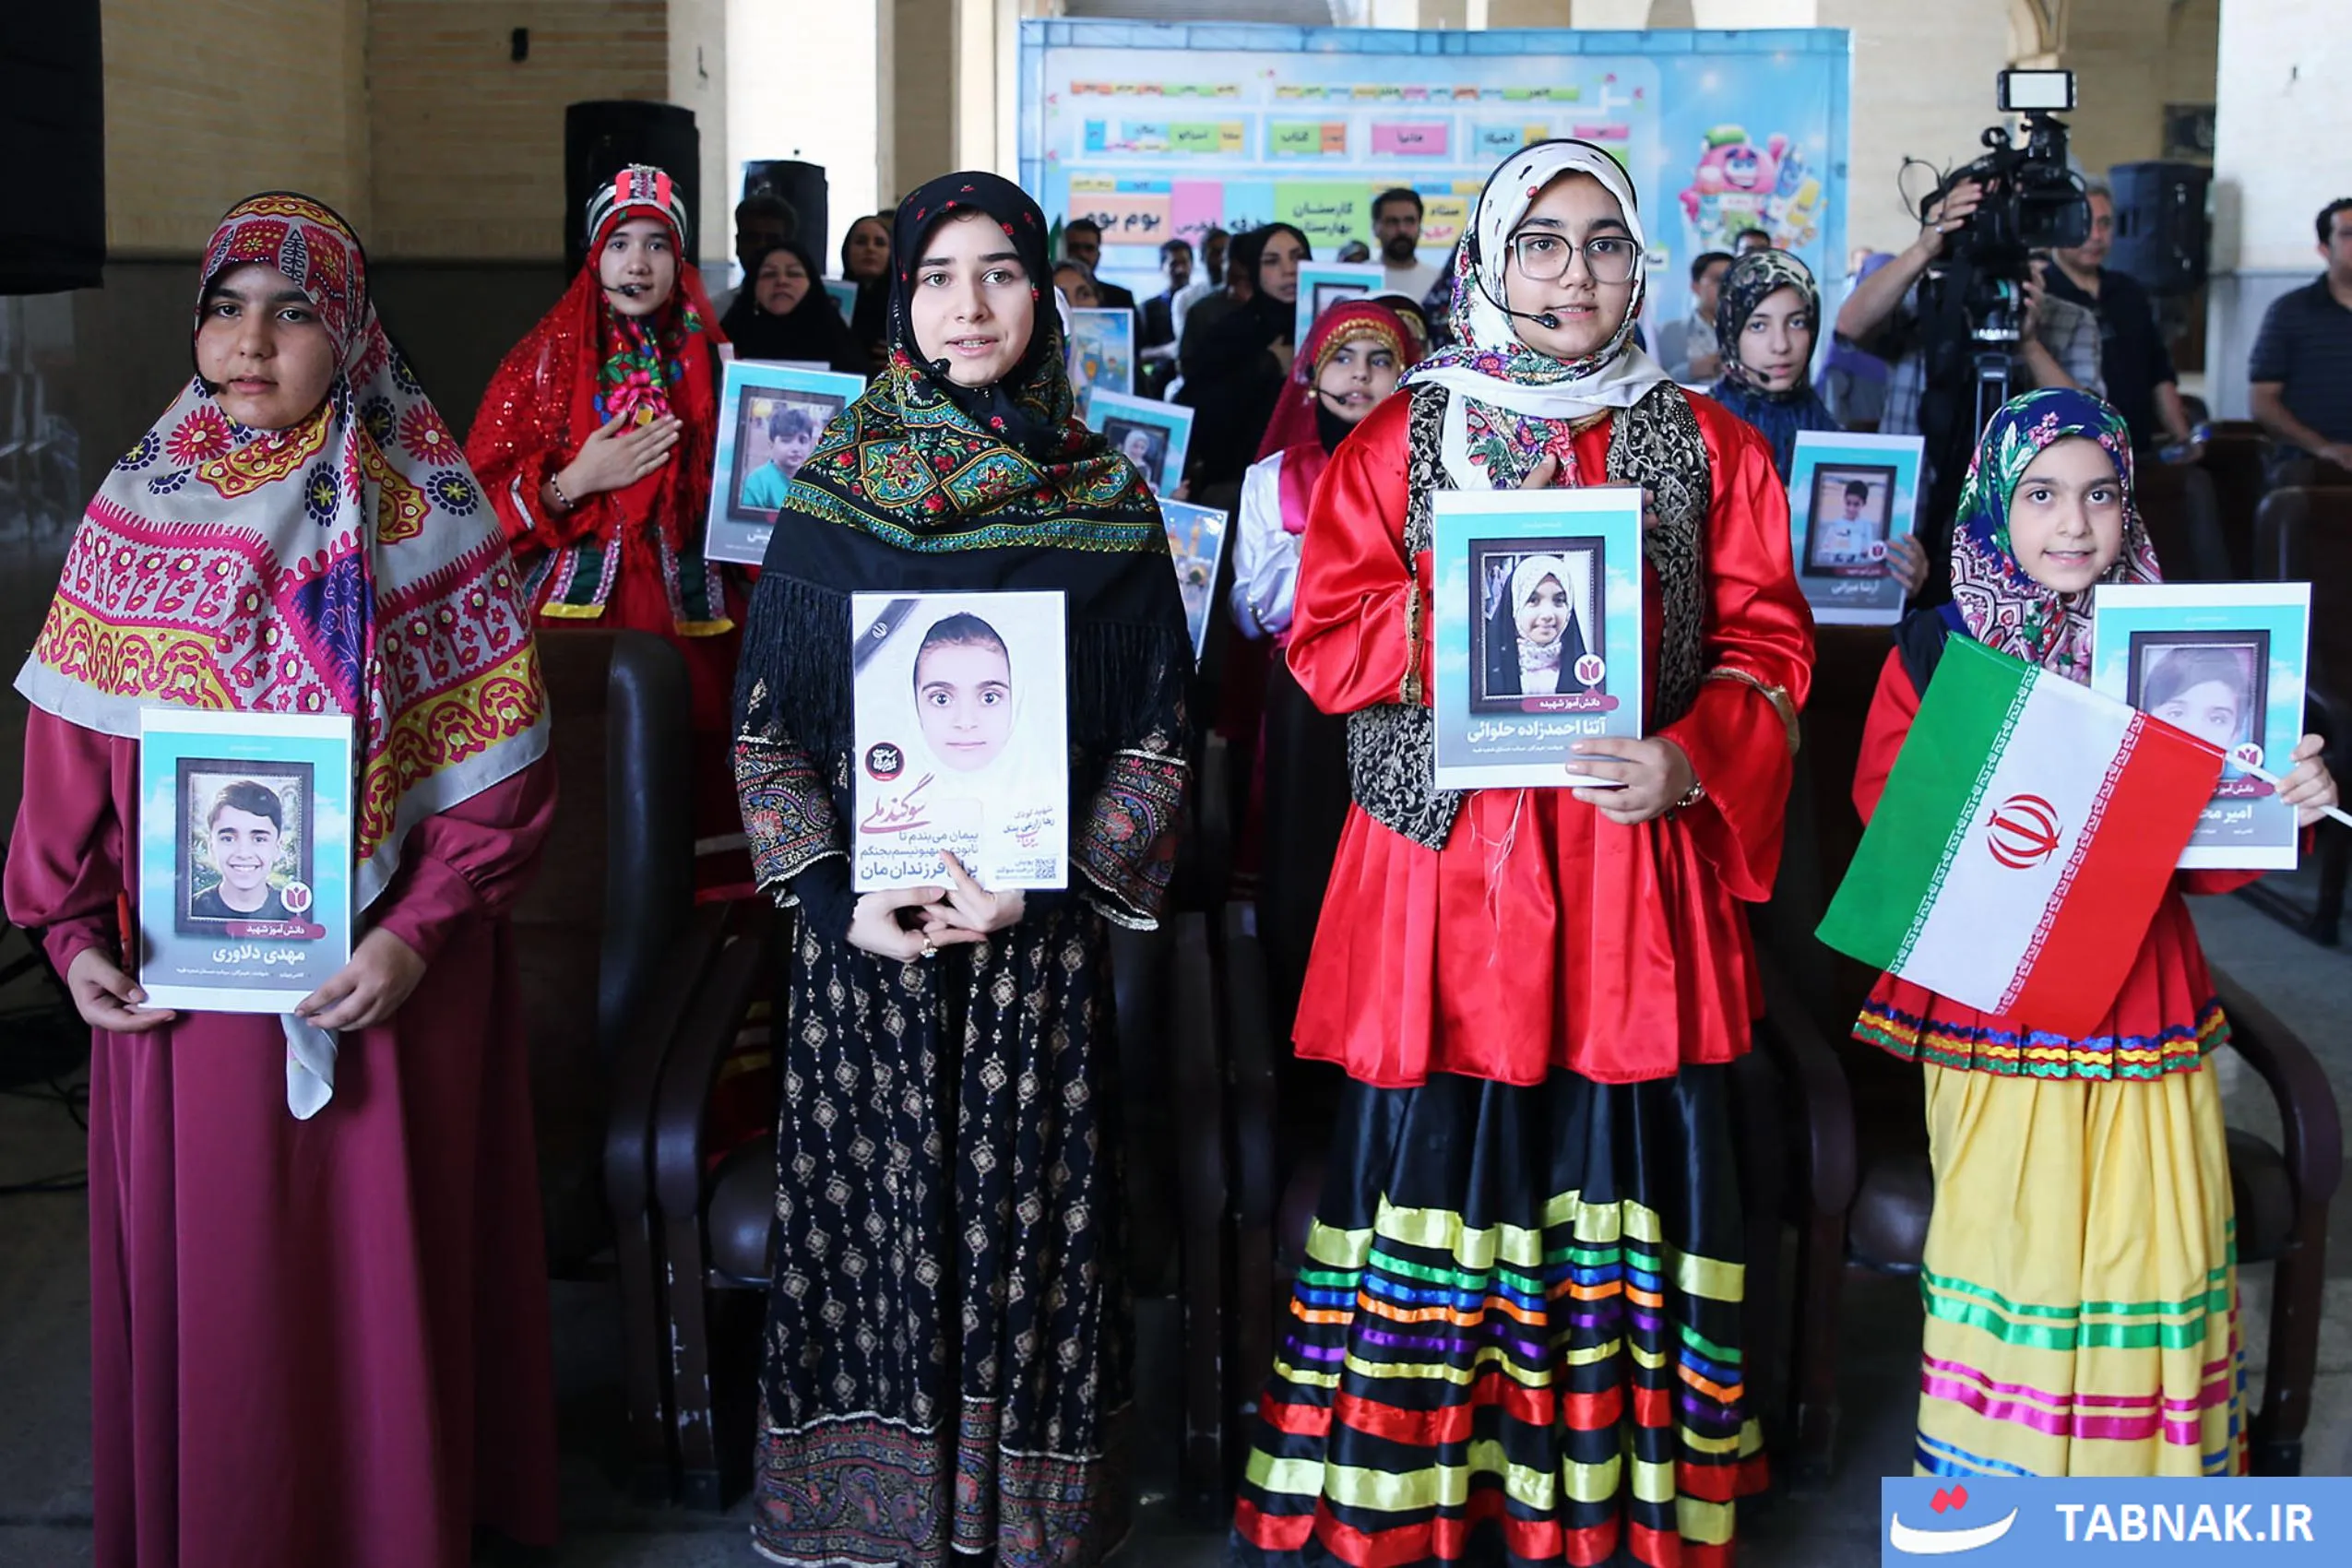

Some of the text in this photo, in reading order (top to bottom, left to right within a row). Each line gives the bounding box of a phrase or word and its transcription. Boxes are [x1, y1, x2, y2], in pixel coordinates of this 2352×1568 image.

[1582, 717, 1607, 734] آتنا
[893, 847, 940, 860] هیونیسم
[212, 944, 305, 965] مهدی دلاوری
